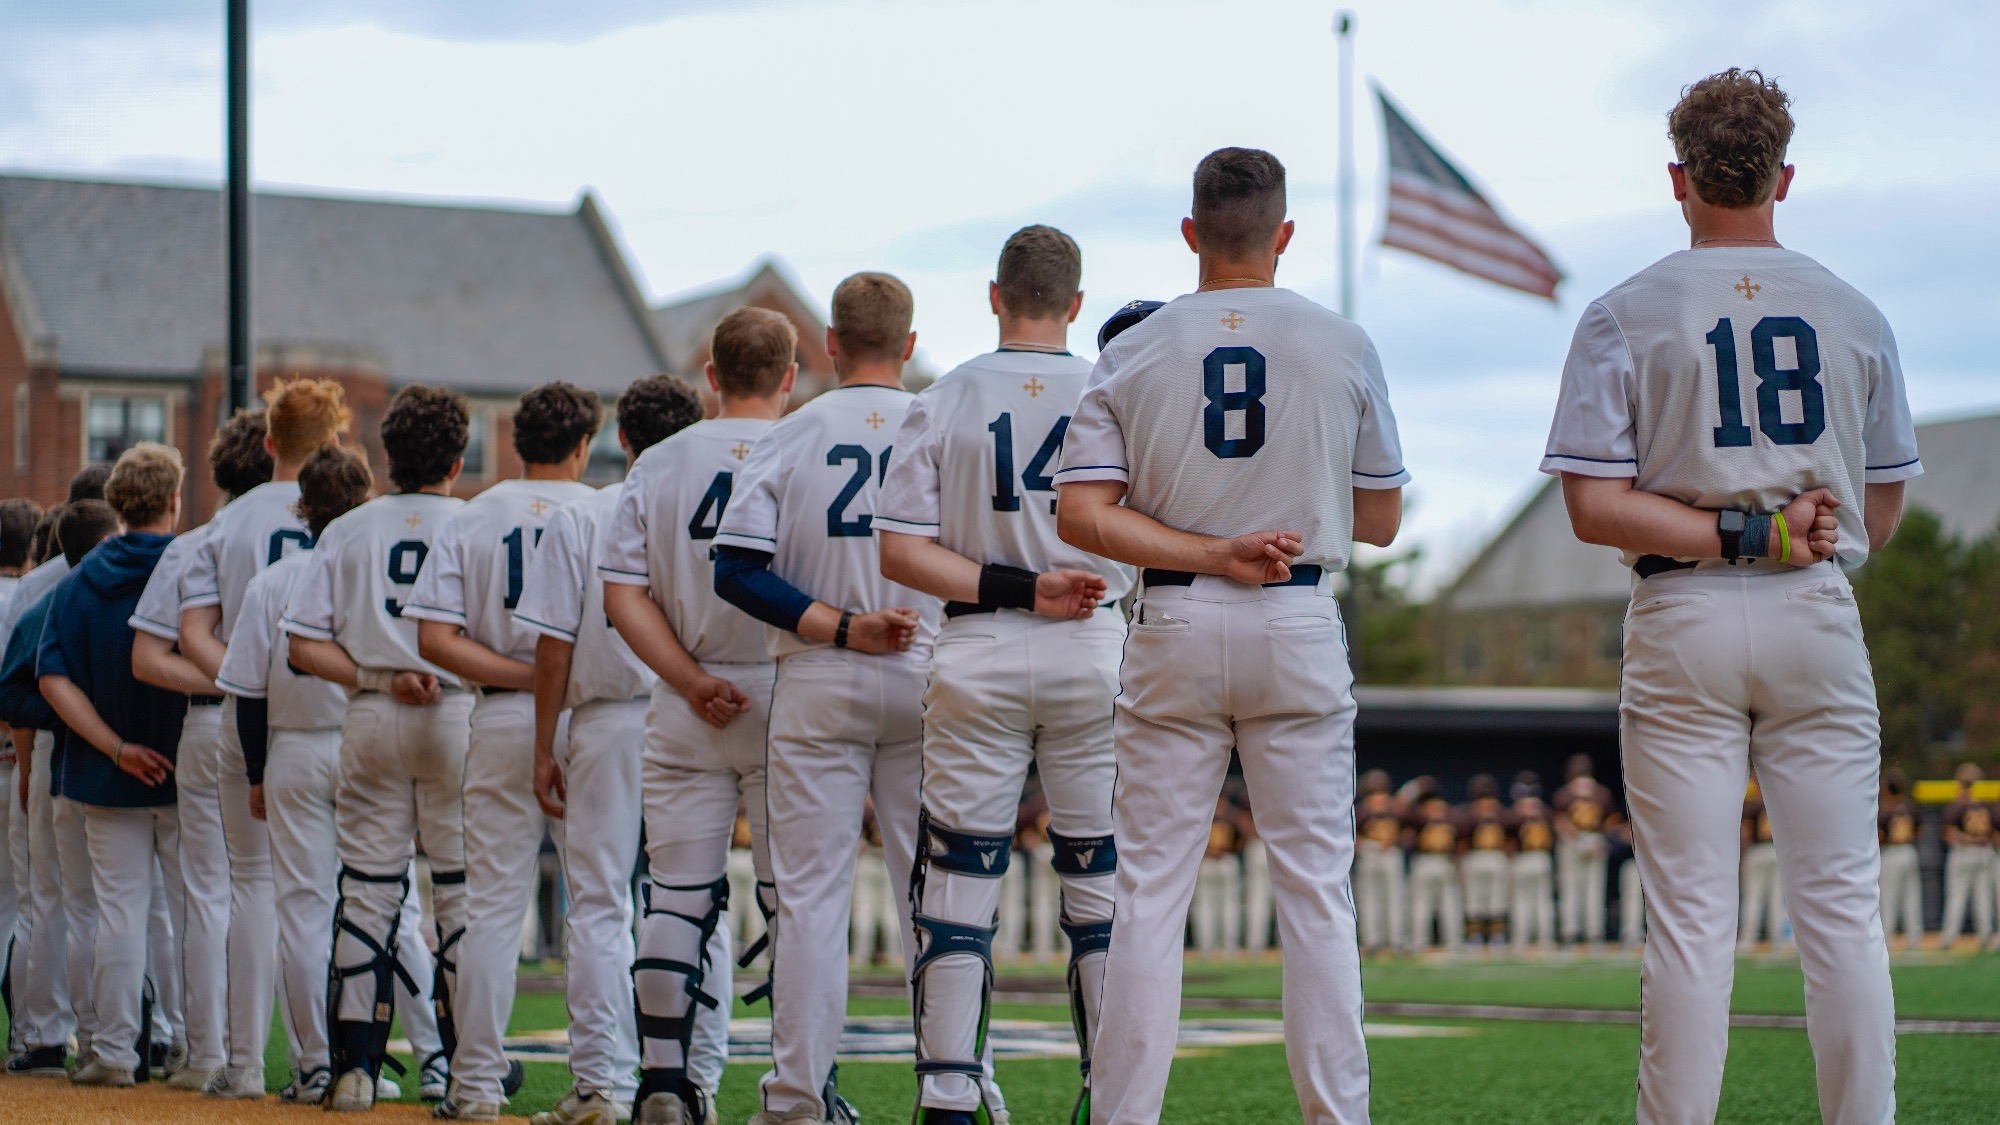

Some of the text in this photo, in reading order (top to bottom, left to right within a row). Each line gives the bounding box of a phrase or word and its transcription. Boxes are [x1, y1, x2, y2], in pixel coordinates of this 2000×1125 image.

[1203, 346, 1266, 459] 8
[1706, 316, 1826, 448] 18
[827, 444, 893, 537] 2
[988, 412, 1072, 514] 14
[385, 540, 429, 618] 9
[503, 526, 544, 609] 1
